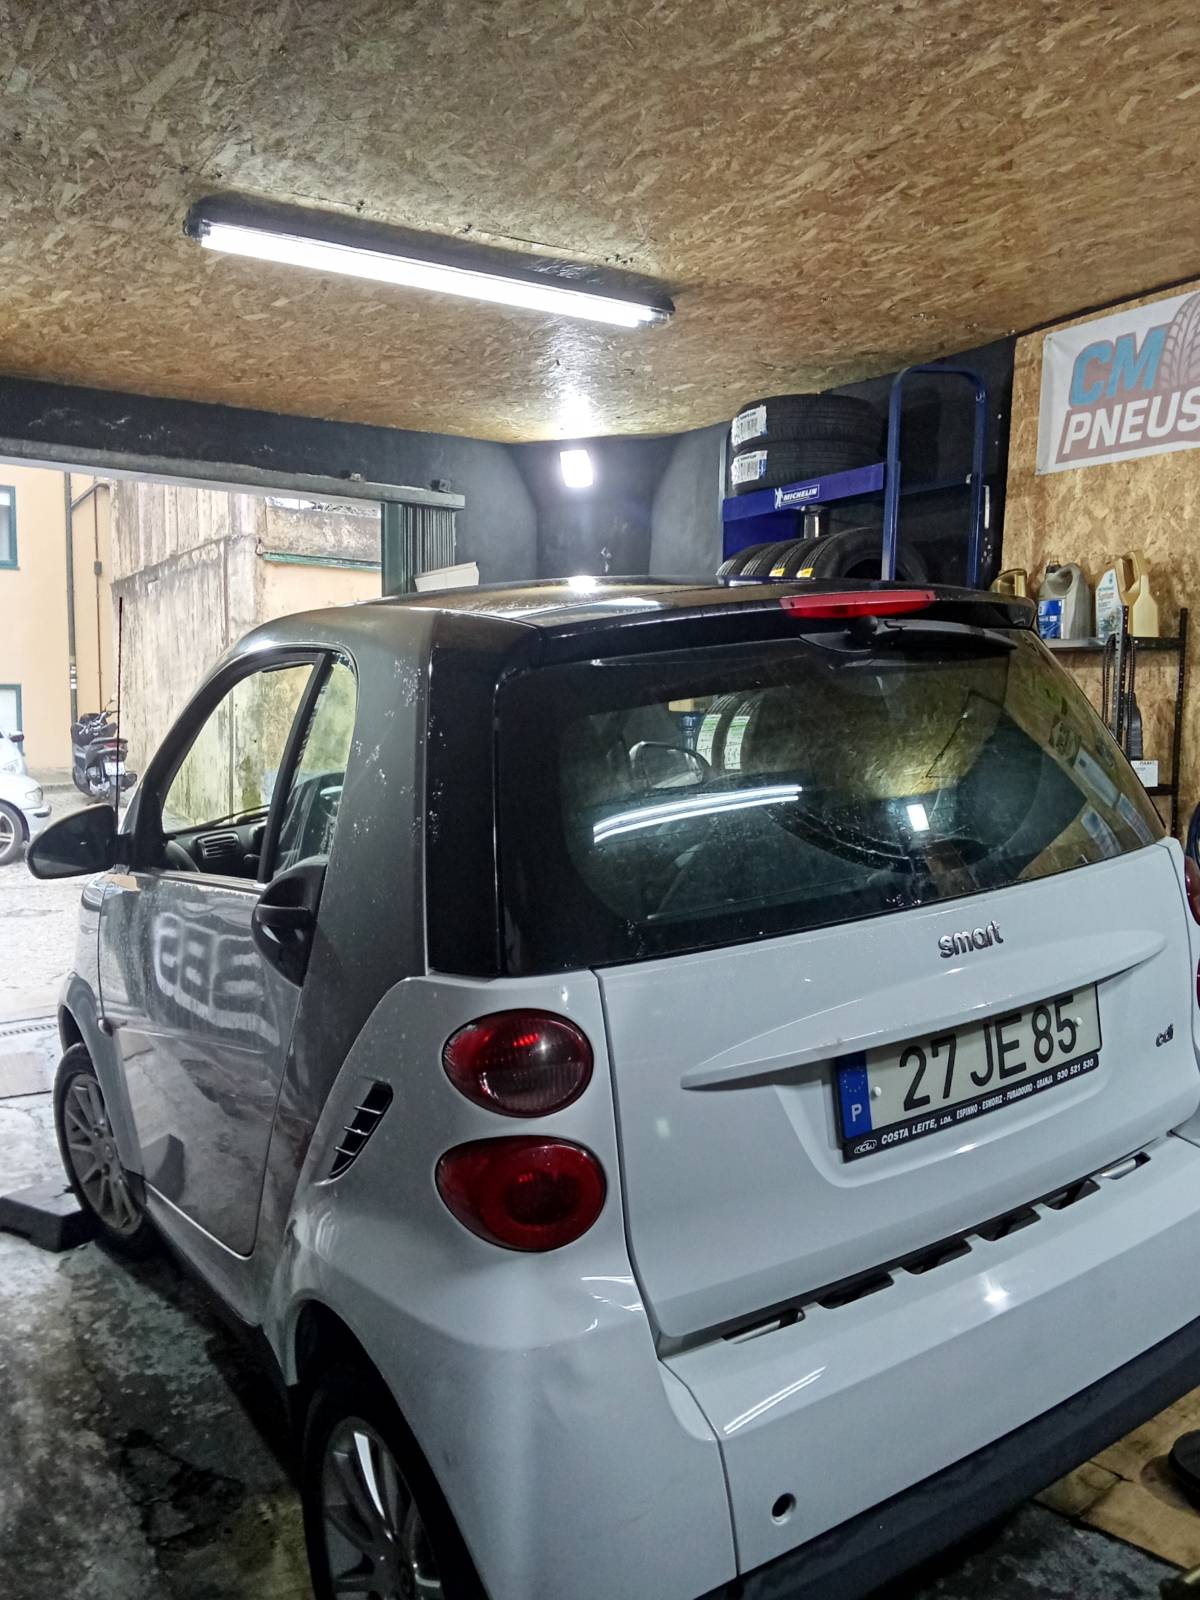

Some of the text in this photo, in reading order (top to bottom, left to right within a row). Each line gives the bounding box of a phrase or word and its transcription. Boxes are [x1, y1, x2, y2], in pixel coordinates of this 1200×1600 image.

[1070, 325, 1169, 407] CM
[1062, 386, 1200, 455] PNEUS
[783, 488, 817, 501] MICHELIN
[938, 920, 1004, 958] smart
[1155, 1023, 1174, 1047] cdi
[899, 995, 1077, 1111] 27 JE 85
[851, 1104, 862, 1122] P
[881, 1128, 909, 1145] COSTA
[911, 1119, 938, 1135] LEITE,
